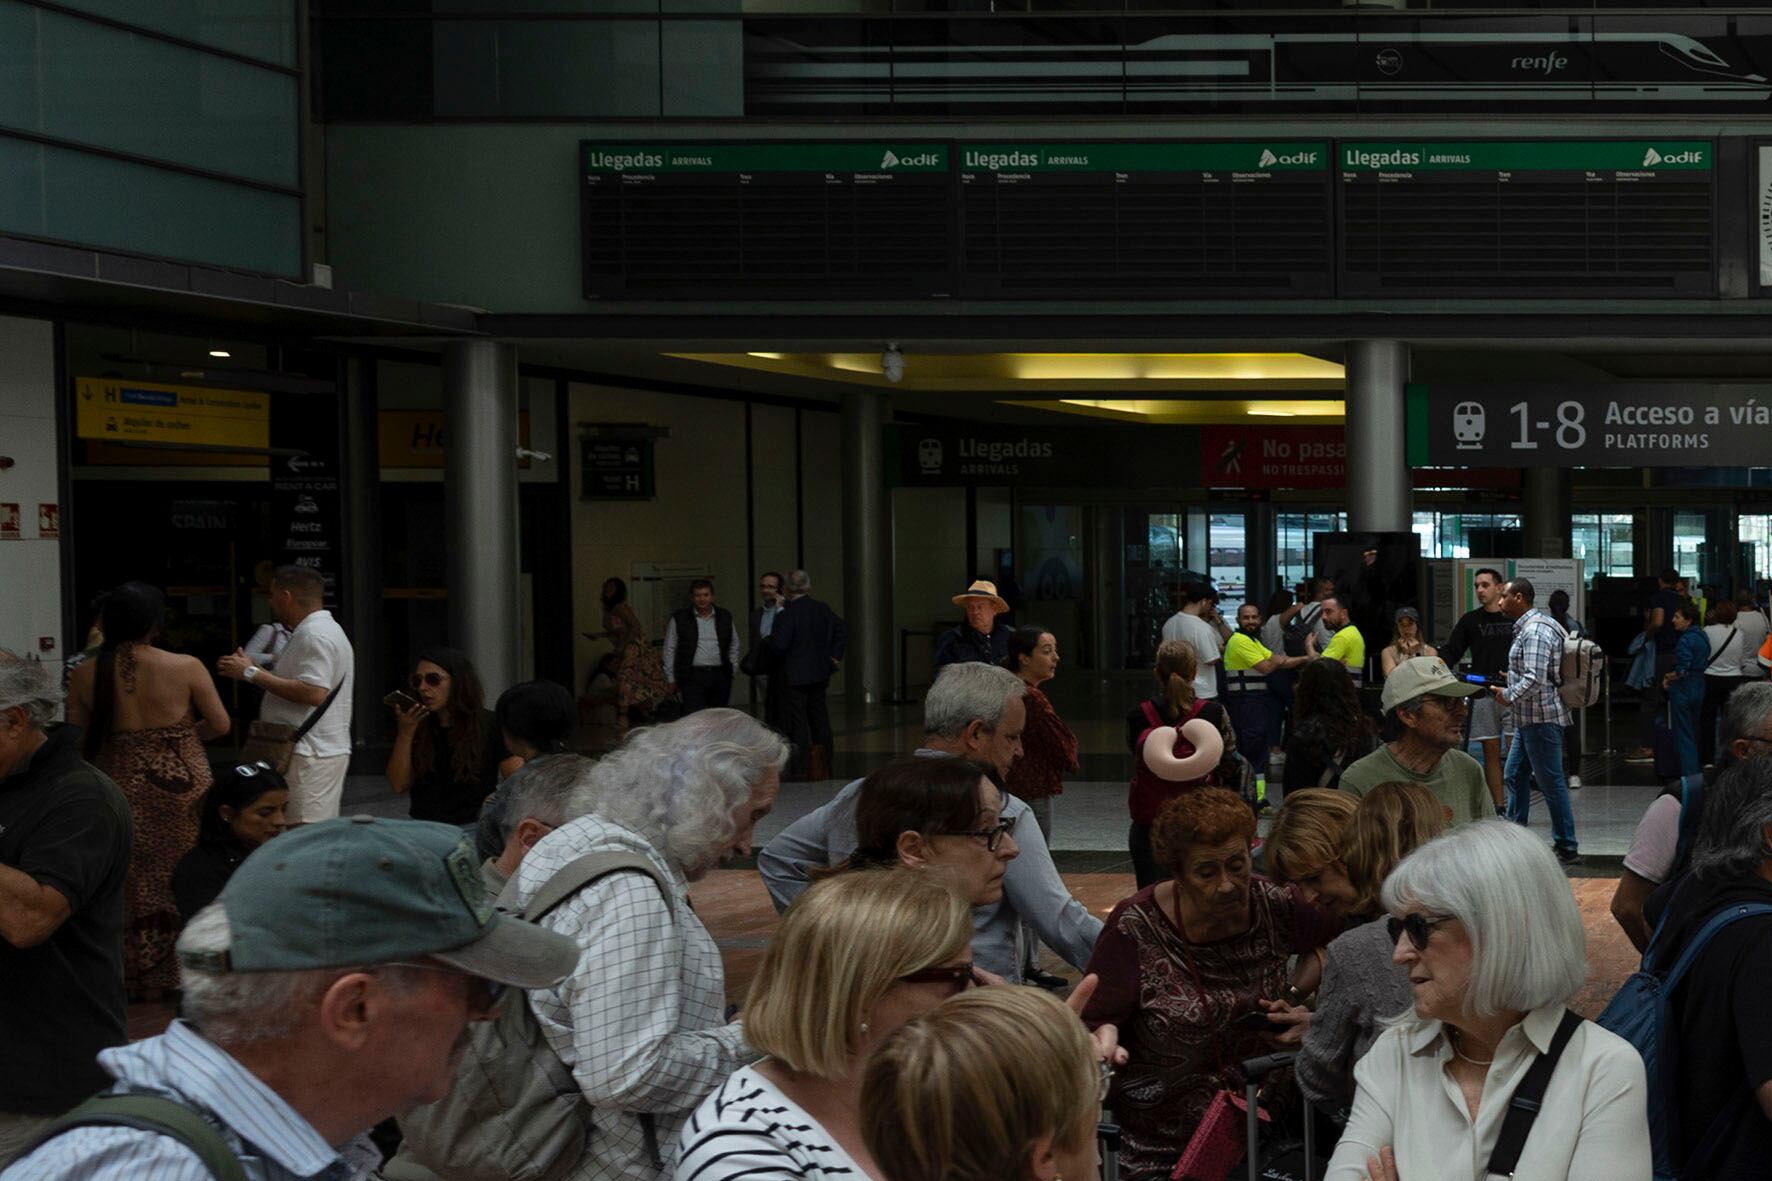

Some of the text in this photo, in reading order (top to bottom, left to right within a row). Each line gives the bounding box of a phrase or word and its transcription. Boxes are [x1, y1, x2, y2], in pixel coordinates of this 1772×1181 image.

[1511, 51, 1568, 75] renfe
[591, 152, 712, 171] Llegadas ARRIVALS
[901, 153, 939, 166] adif
[966, 151, 1088, 170] Llegadas ARRIVALS
[1279, 152, 1317, 164] adif
[1346, 150, 1471, 168] Llegadas ARRIVALS
[1663, 151, 1703, 164] adif
[1509, 400, 1588, 450] 1-8
[1605, 401, 1695, 426] Acceso
[1704, 406, 1720, 426] a
[959, 437, 1053, 463] Llegadas
[1605, 433, 1709, 449] PLATFORMS
[1262, 440, 1345, 462] No pasa
[960, 464, 1020, 476] ARRIVALS
